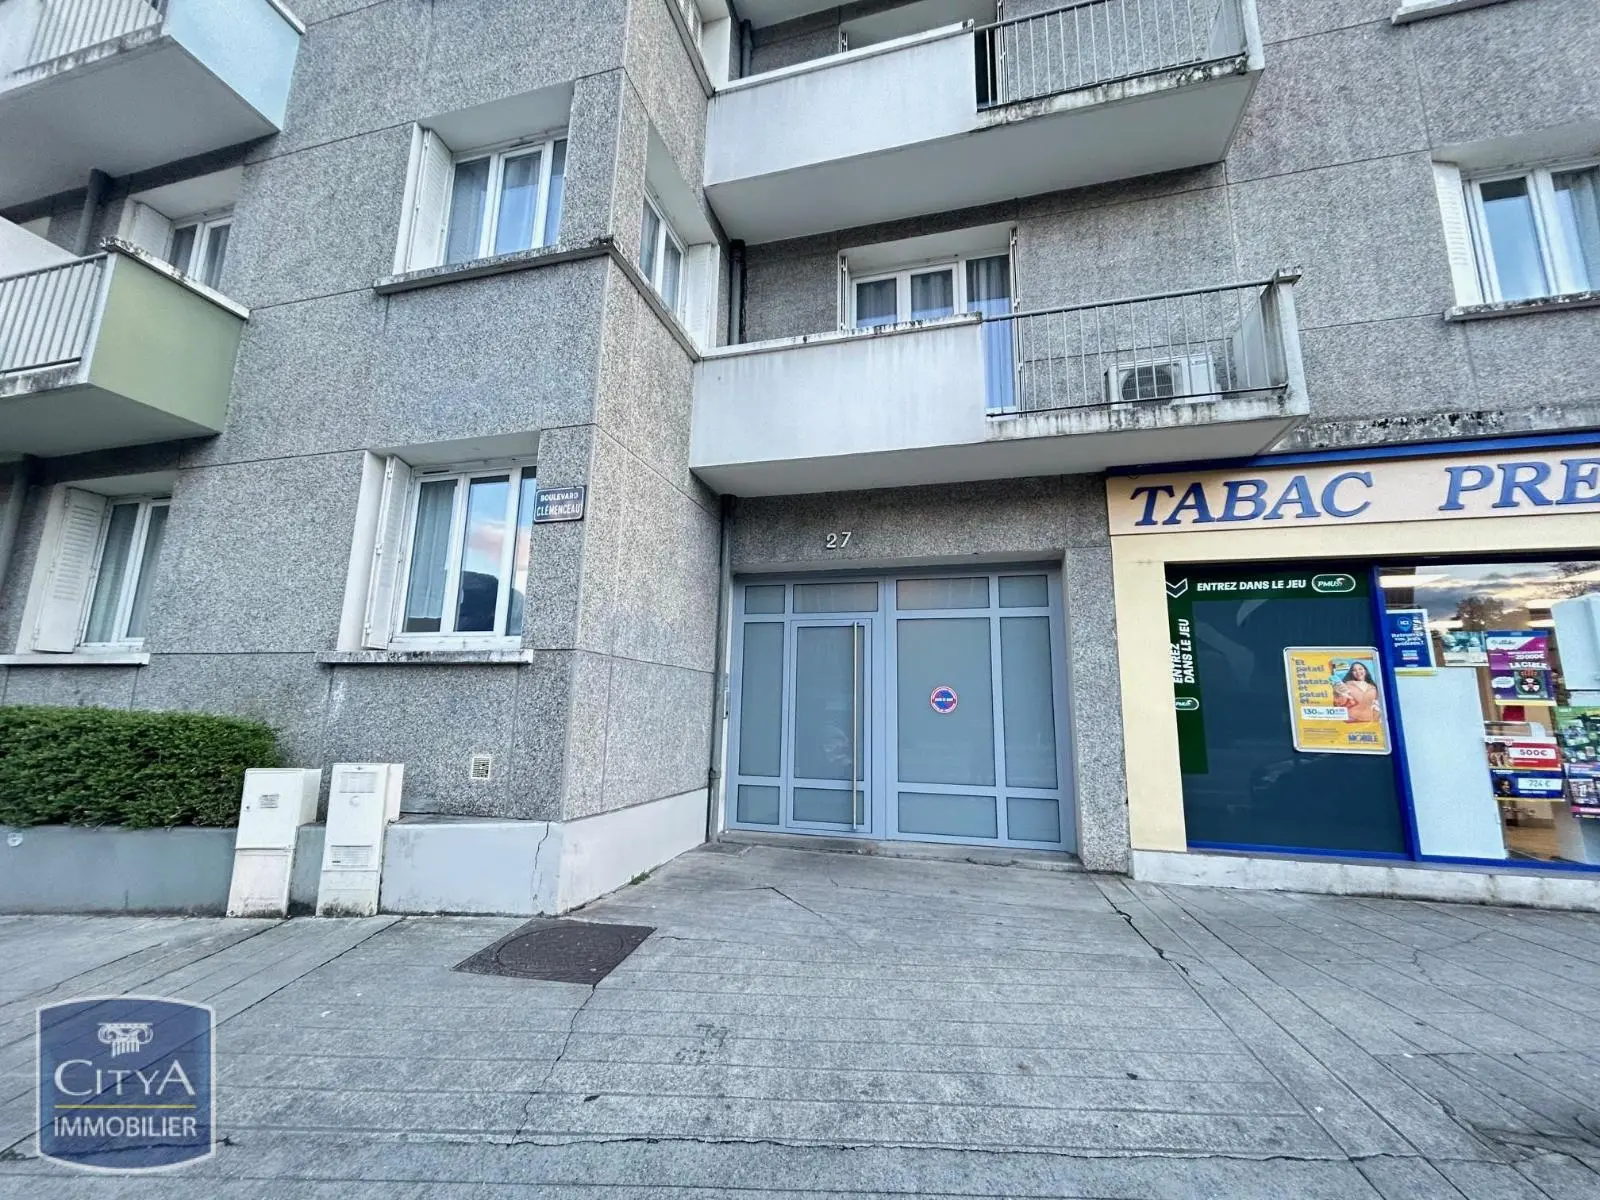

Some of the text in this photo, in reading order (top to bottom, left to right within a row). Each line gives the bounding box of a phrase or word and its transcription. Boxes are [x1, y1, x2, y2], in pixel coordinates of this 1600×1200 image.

[540, 492, 579, 502] BOULEVARD
[1131, 458, 1600, 526] TABAC PRE
[826, 531, 852, 548] 27
[1196, 579, 1306, 592] ENTREZ DANS LE JEU
[1178, 618, 1195, 684] DANS LE JEU
[1519, 748, 1548, 756] 500€
